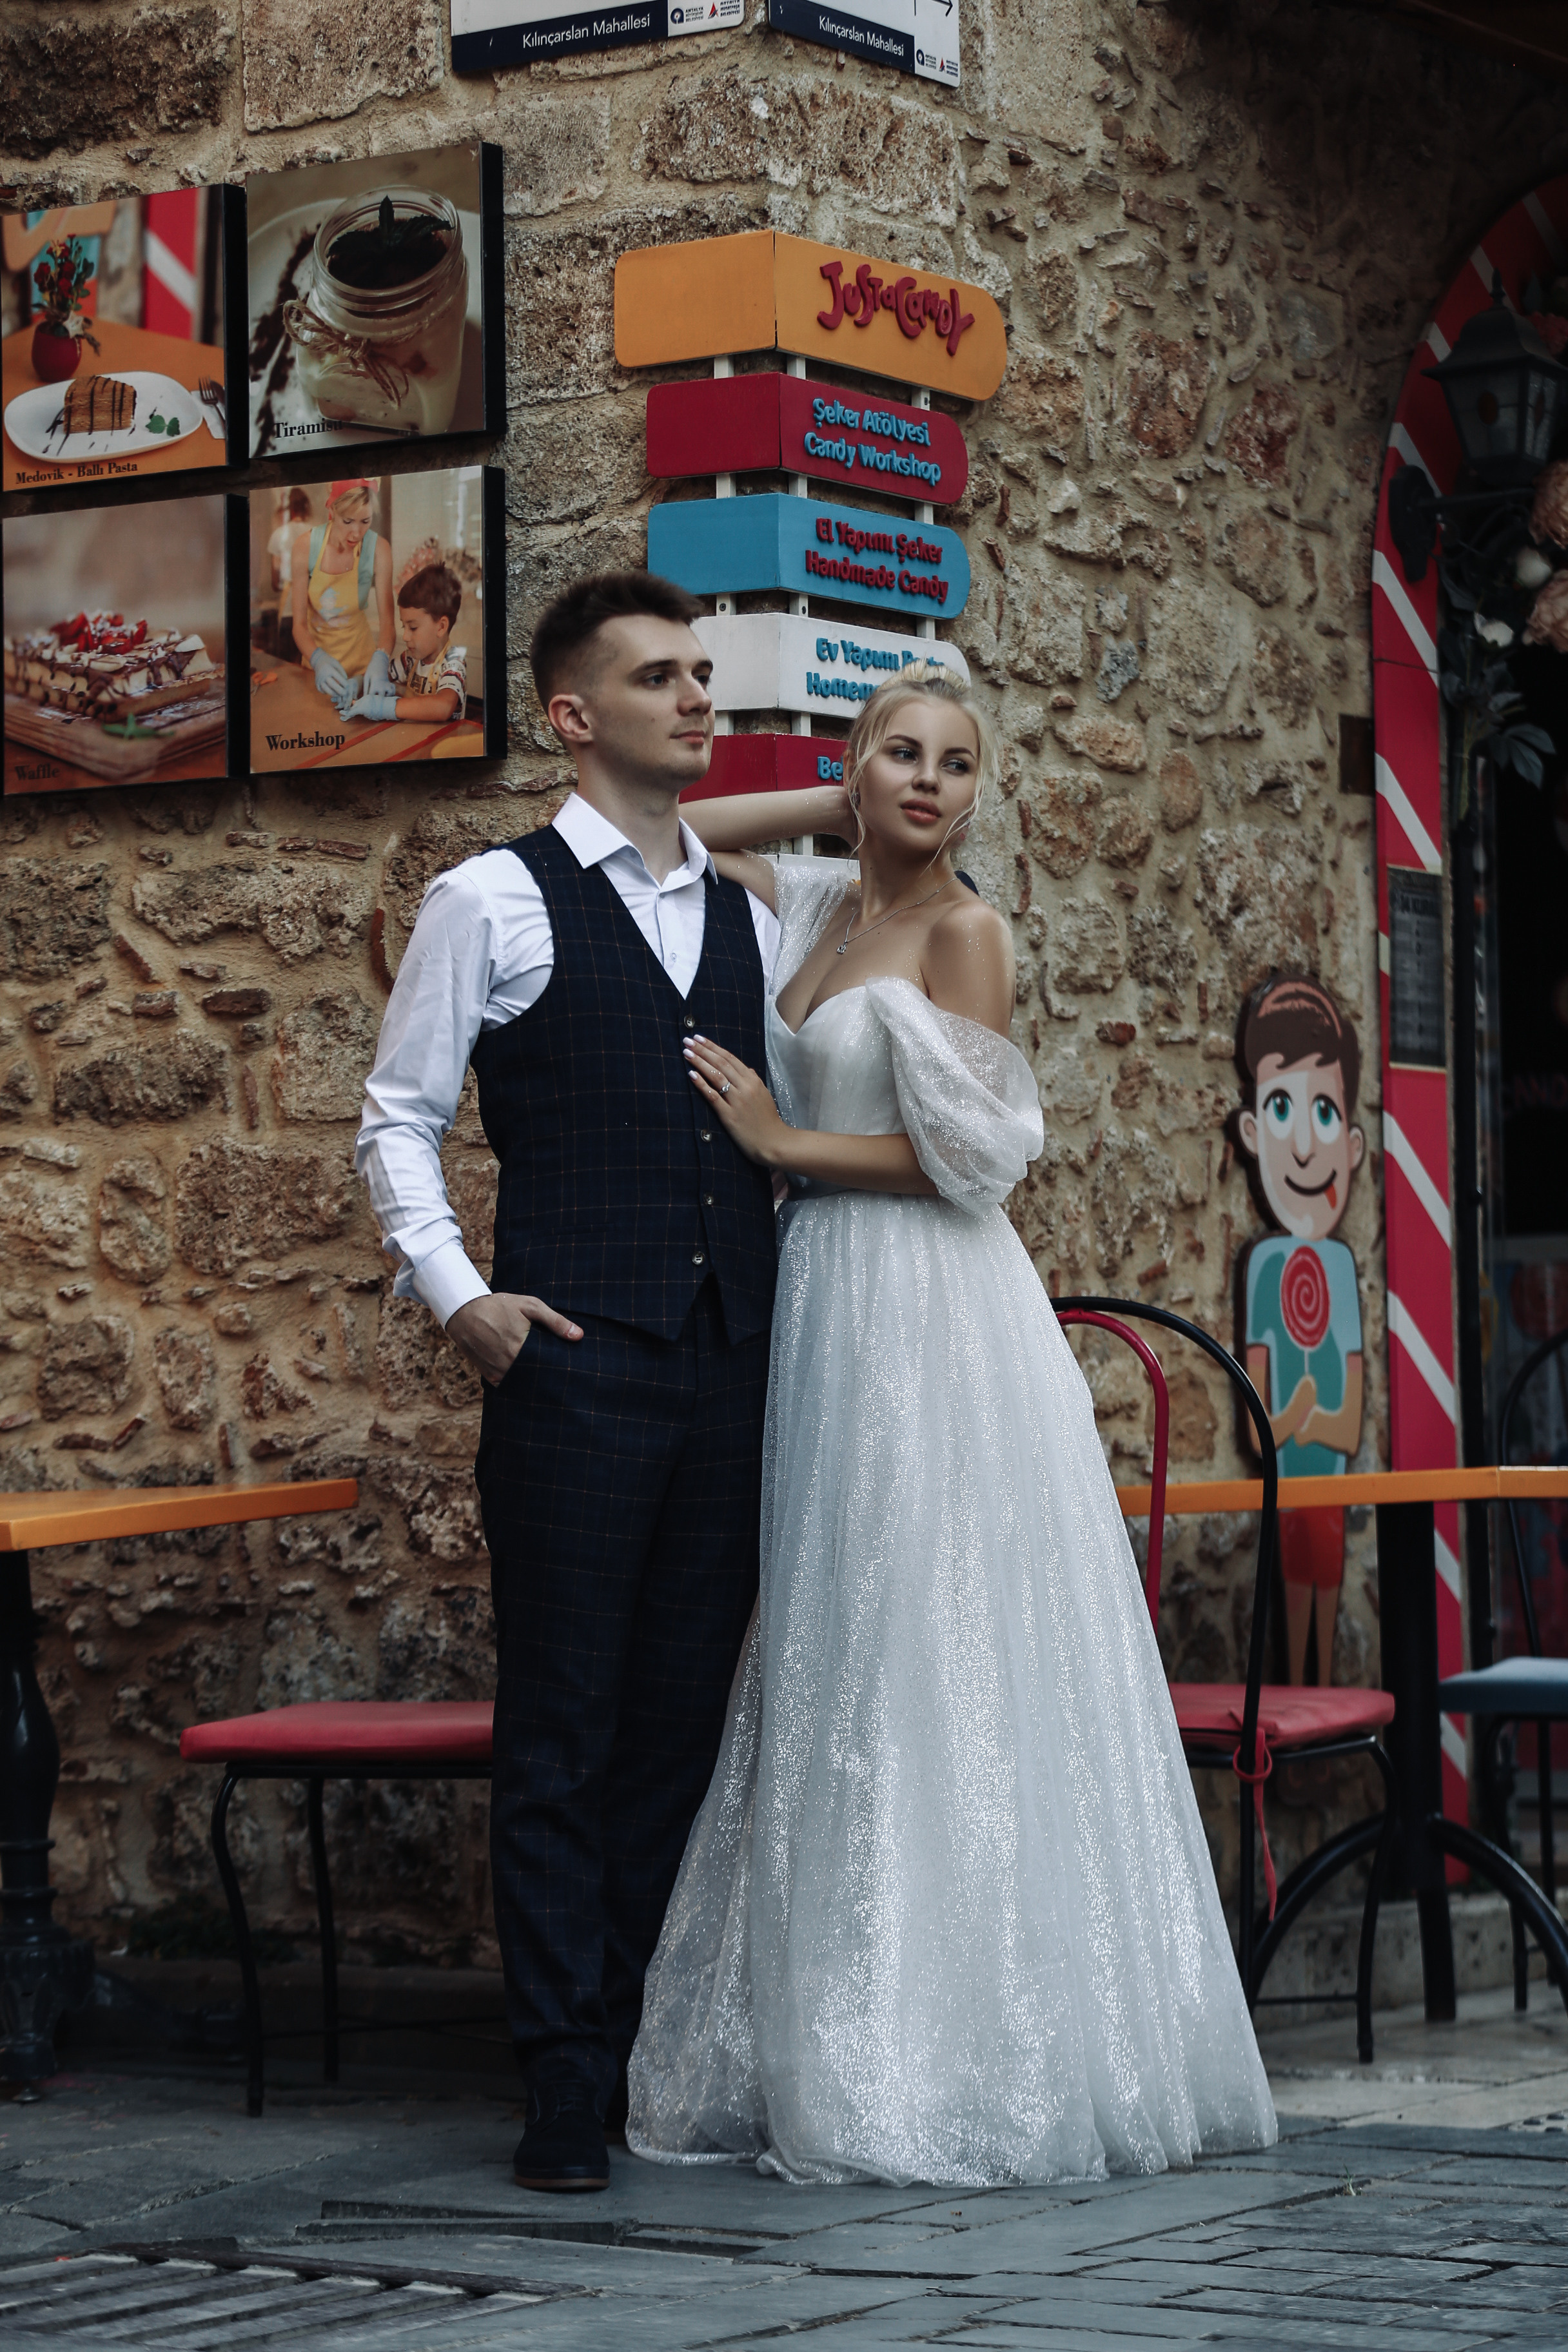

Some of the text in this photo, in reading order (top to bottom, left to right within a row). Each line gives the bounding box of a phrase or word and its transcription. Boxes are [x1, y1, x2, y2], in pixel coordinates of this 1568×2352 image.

[523, 13, 651, 48] Kılınçarslan Mahallesi
[819, 15, 904, 57] Kılınçarslan Mahallesi
[812, 397, 931, 446] Şeker Atölyesi
[16, 468, 64, 484] Medovik
[77, 464, 104, 478] Ballı
[108, 462, 138, 475] Pasta
[804, 431, 941, 487] Candy Workshop
[816, 517, 943, 564] El Yapımı Şeker
[805, 549, 949, 604] Handmade Candy
[816, 637, 839, 662] Ev
[840, 640, 901, 672] Yapımı
[806, 671, 879, 701] Homem
[265, 730, 345, 751] Workshop
[15, 763, 60, 780] Waffle
[817, 756, 844, 781] Be
